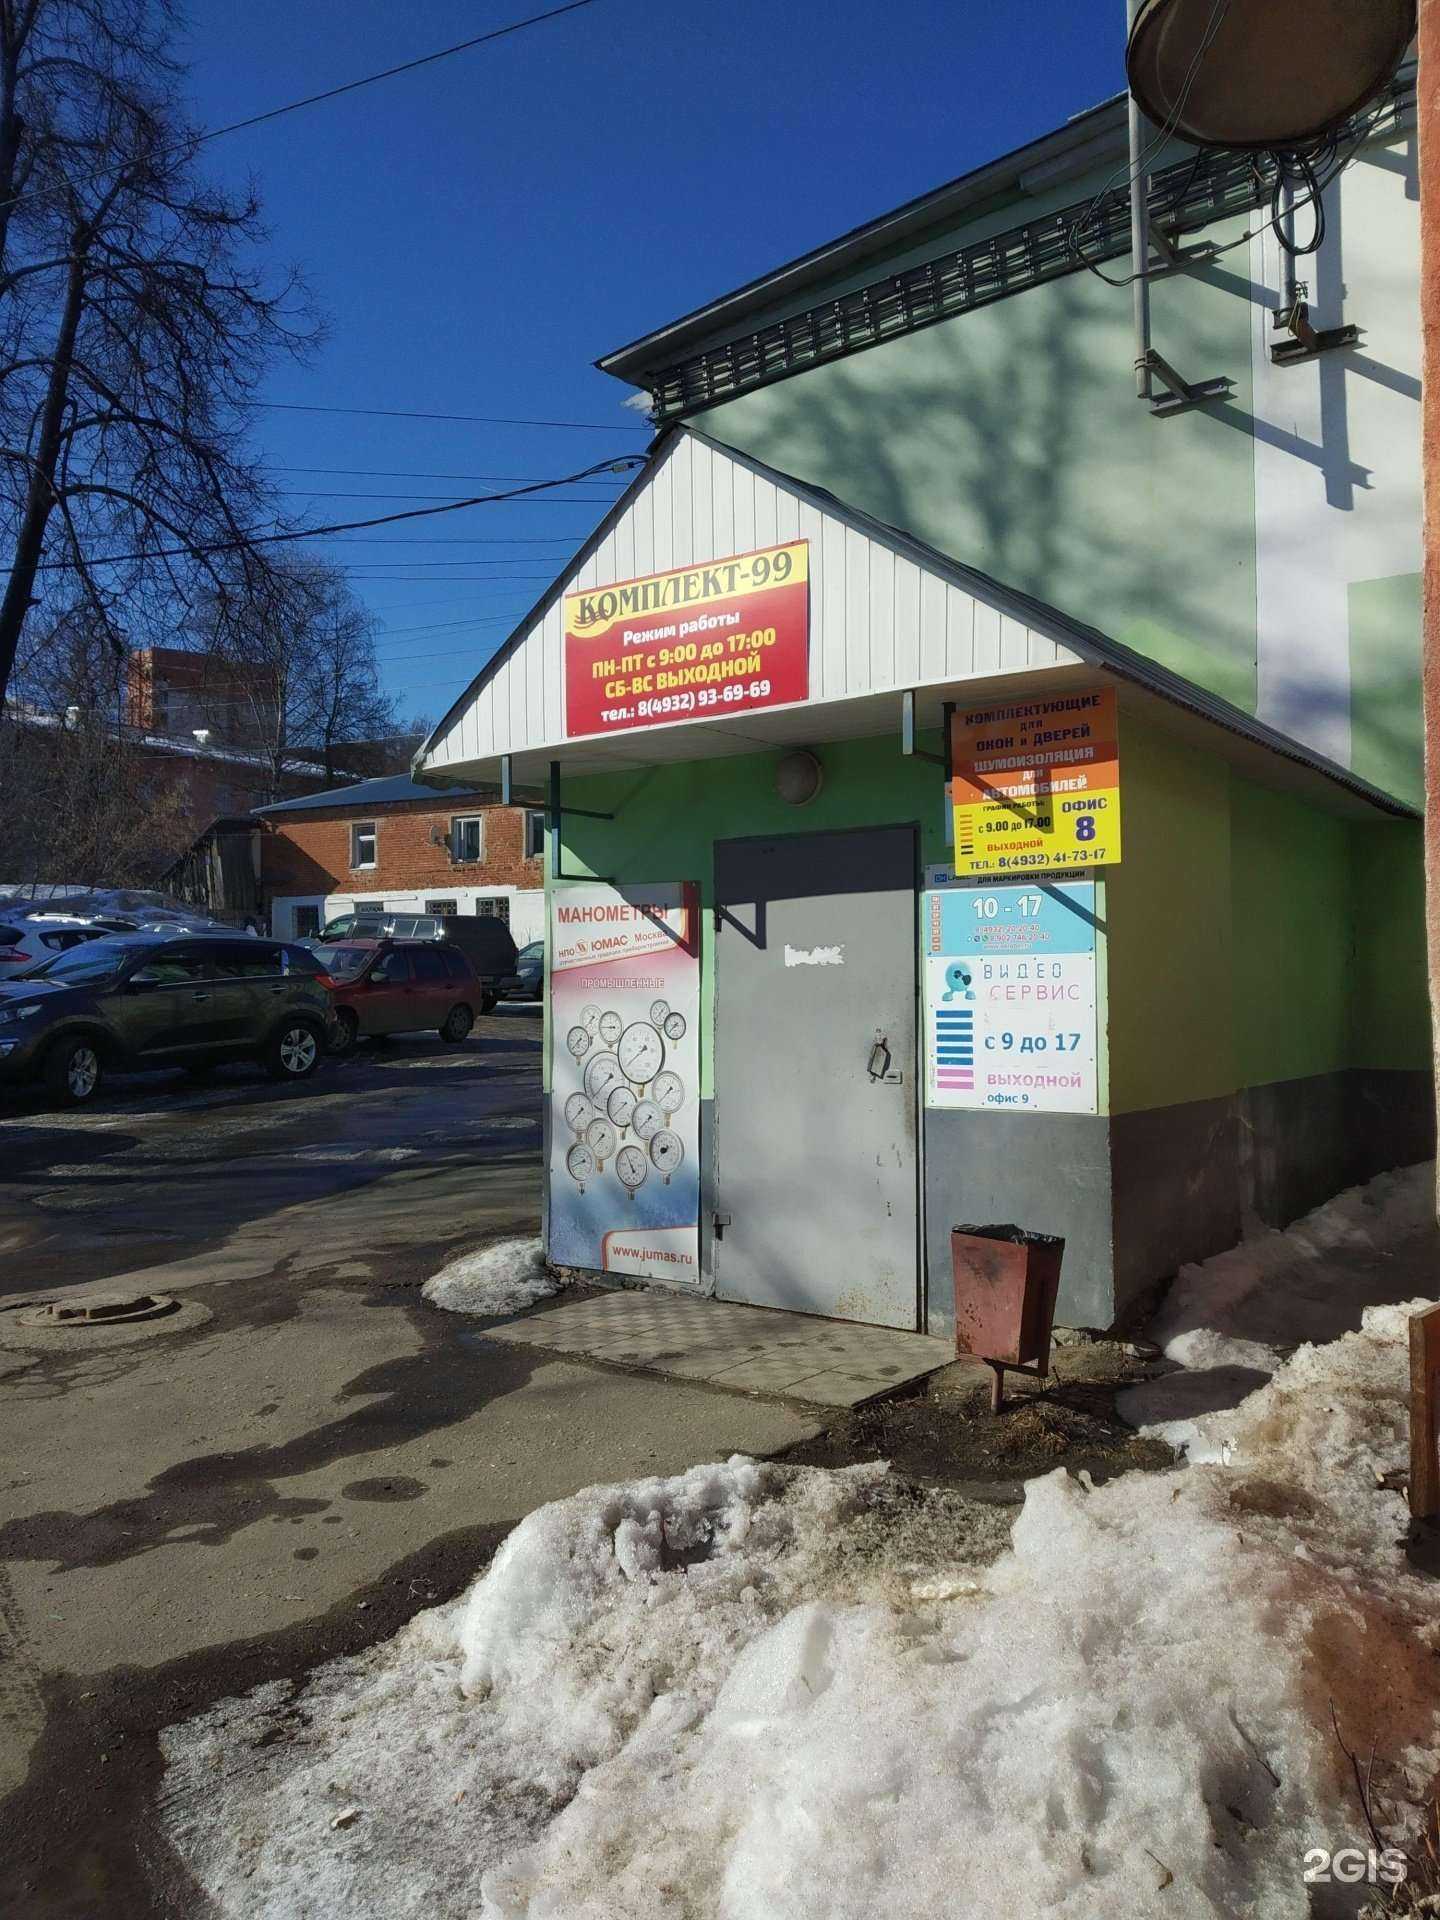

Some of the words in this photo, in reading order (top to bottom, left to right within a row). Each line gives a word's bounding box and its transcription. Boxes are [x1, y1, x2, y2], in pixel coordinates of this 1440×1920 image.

[576, 551, 792, 623] КОМПЛЕКТ-99
[623, 627, 676, 646] Режим
[680, 612, 740, 634] работы
[592, 654, 643, 678] ПН-ПТ
[647, 657, 656, 667] с
[659, 643, 697, 666] 9:00
[700, 641, 724, 660] до
[727, 628, 776, 652] 17:00
[605, 675, 653, 699] СБ-ВС
[656, 651, 761, 691] ВЫХОДНОЙ
[601, 703, 635, 722] тел.:
[638, 691, 695, 717] 8(4932)
[698, 680, 771, 706] 93-69-69
[965, 695, 1100, 726] КОМПЛЕКТУЮЩИЕ
[976, 737, 1013, 751] ОКОН
[1034, 723, 1090, 746] ДВЕРЕЙ
[974, 747, 1094, 772] ШУМОИЗОЛЯЦИЯ
[982, 775, 1088, 800] АВТОМОБИЛЕЙ
[983, 804, 1012, 812] ГРАФИК
[1062, 798, 1107, 813] ОФИС
[986, 821, 1008, 832] 9.00
[1024, 816, 1050, 829] 17.00
[1075, 815, 1096, 841] 8
[1053, 848, 1106, 864] 41-73-17
[992, 873, 1040, 883] МАРКИРОВКИ
[1041, 870, 1085, 880] ПРОДУКЦИИ
[558, 904, 668, 922] МАНОМЕТРЫ
[972, 897, 999, 919] 10
[1016, 895, 1043, 917] 17
[591, 935, 628, 951] ЮМАС
[984, 963, 1062, 979] ВИДЕО
[990, 984, 1080, 1000] СЕРВИС
[984, 1036, 995, 1050] с
[1001, 1032, 1014, 1050] 9
[1020, 1036, 1047, 1053] до
[1055, 1033, 1081, 1051] 17
[987, 1092, 1018, 1104] офис
[1022, 1094, 1029, 1104] 9
[612, 1246, 693, 1264] www.jumas.ru
